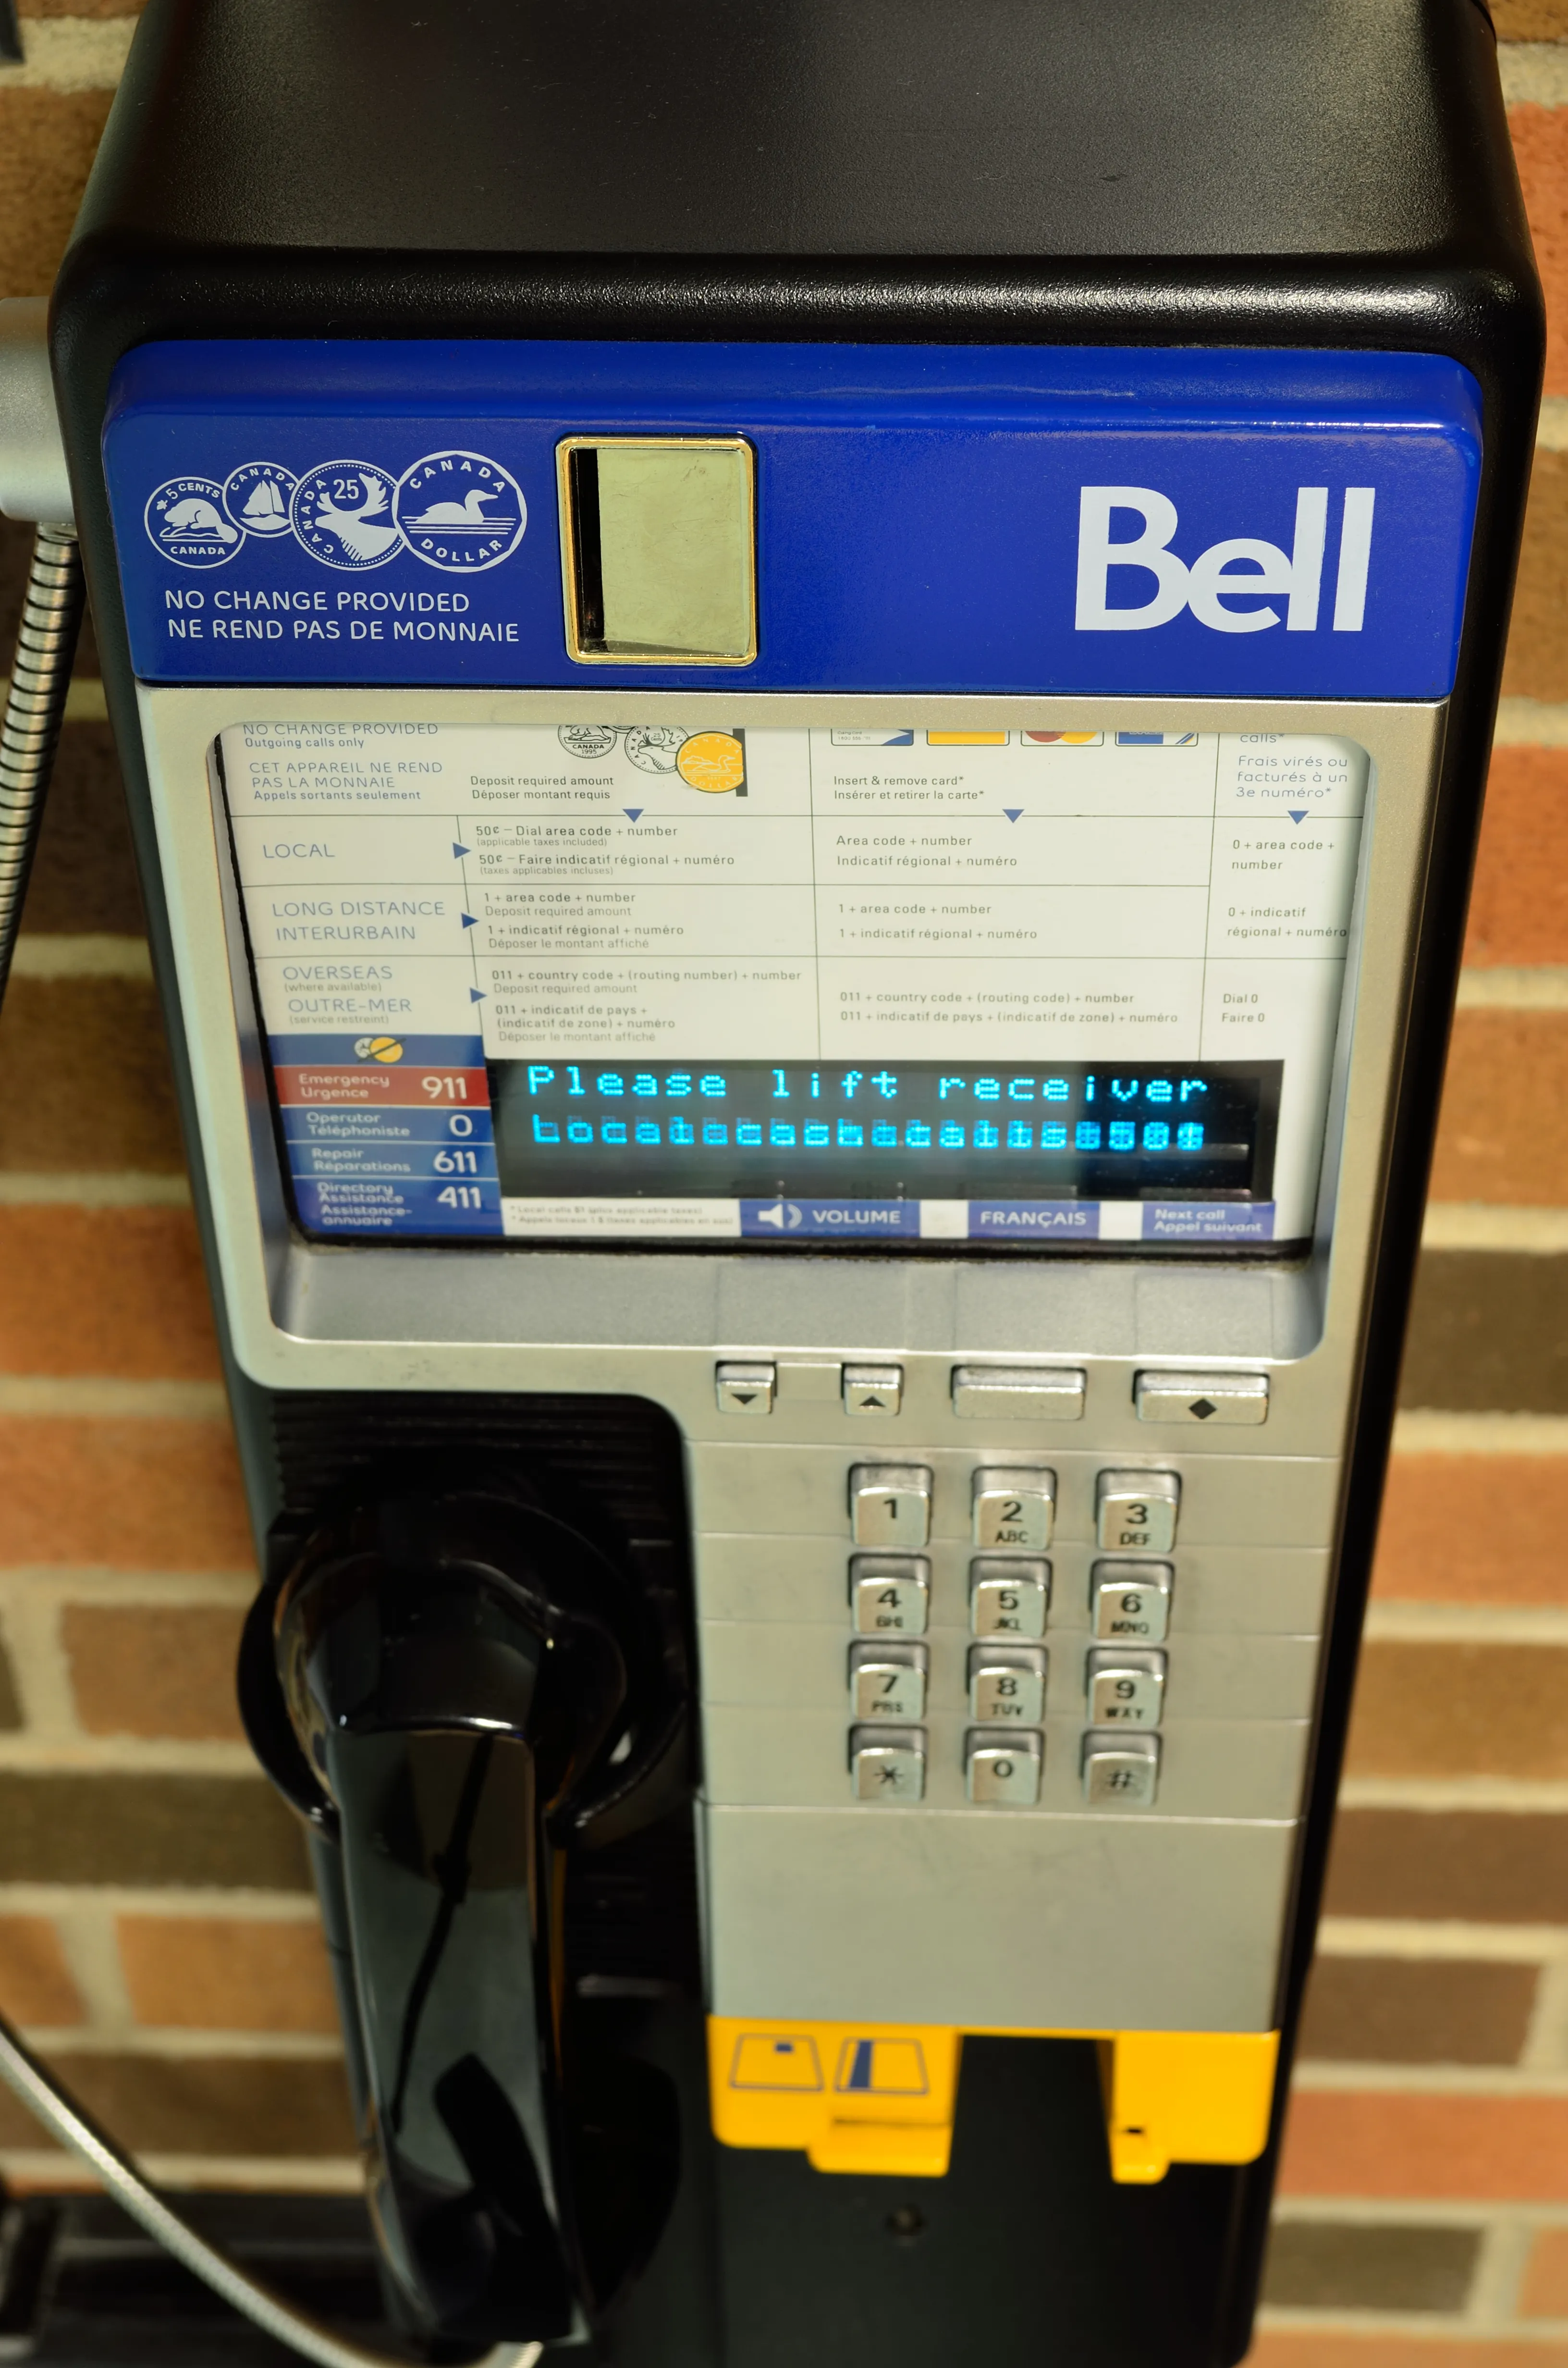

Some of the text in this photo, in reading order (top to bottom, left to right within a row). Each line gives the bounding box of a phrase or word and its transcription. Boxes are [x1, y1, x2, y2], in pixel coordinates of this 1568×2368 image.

[231, 467, 296, 492] CANADA
[410, 460, 506, 493] CANADA
[170, 482, 221, 500] 5 CENTS
[333, 479, 358, 500] 25
[171, 546, 225, 555] CANADA
[420, 537, 503, 563] DOLLAR
[1075, 486, 1375, 632] Bell
[165, 590, 469, 612] NO CHANGE PROVIDED
[168, 619, 519, 642] NE REND PAS DE MONNAIE
[243, 722, 440, 735] NO CHANGE PROVIDED
[245, 737, 364, 749] Outgoing calls only
[249, 762, 442, 773] CET APPAREIL NE REND
[1238, 755, 1348, 767] Frais virés ou
[252, 777, 395, 788] PAS LA MONNAIE
[470, 776, 613, 787] Deposit required amount
[834, 776, 868, 785] Insert
[871, 776, 880, 785] &
[1237, 771, 1306, 782] facturés
[1312, 772, 1322, 782] à
[254, 790, 421, 802] Appels sortants seulement
[472, 789, 610, 801] Déposer montant requis
[834, 790, 876, 800] Insérer
[880, 791, 891, 800] et
[894, 790, 930, 799] retirer
[934, 790, 943, 800] la
[1236, 787, 1255, 797] 3e
[516, 826, 541, 836] Dial
[579, 826, 611, 836] code
[627, 826, 677, 836] number
[477, 838, 530, 847] (applicable
[563, 838, 607, 846] included)
[836, 835, 972, 846] Area code number
[1290, 840, 1323, 850] code
[263, 843, 335, 858] LOCAL
[519, 854, 551, 864] Faire
[556, 854, 610, 864] indicatif
[614, 854, 669, 867] régional
[684, 855, 734, 865] numéro
[837, 855, 1017, 868] Indicatif régional numéro
[1232, 860, 1283, 870] number
[480, 866, 613, 876] (taxes applicables incluses)
[506, 892, 636, 902] area code number
[272, 901, 445, 917] LONG DISTANCE
[894, 904, 926, 914] code
[942, 904, 992, 914] number
[1251, 907, 1306, 917] indicatif
[276, 926, 416, 941] INTERURBAIN
[509, 925, 684, 937] indicatif régional numéro
[861, 928, 1037, 941] indicatif régional numéro
[1227, 926, 1347, 938] régional numéro
[282, 966, 392, 980] OVERSEAS
[840, 992, 1134, 1005] 011 country code (routing code) number
[1223, 993, 1248, 1004] Dial
[288, 999, 412, 1013] OUTRE-MER
[1222, 1012, 1254, 1023] Faire
[299, 1073, 390, 1088] Emergency
[528, 1066, 1207, 1102] Please lift receiver
[301, 1087, 369, 1100] Urgence
[422, 1076, 466, 1099] 911
[306, 1111, 381, 1125] Operator
[449, 1114, 472, 1136] 0
[312, 1147, 363, 1160] Repair
[433, 1151, 477, 1173] 611
[438, 1186, 481, 1209] 411
[813, 1210, 900, 1223] VOLUME
[980, 1211, 1087, 1228] FRANÇAIS
[1155, 1209, 1225, 1220] Next call
[1154, 1221, 1262, 1233] Appel suivant
[884, 1498, 897, 1519] 1
[1001, 1501, 1022, 1522] 2
[1126, 1504, 1147, 1525] 3
[995, 1530, 1026, 1543] ABC
[877, 1589, 900, 1608] 4
[999, 1590, 1018, 1610] 5
[1121, 1594, 1141, 1613] 6
[879, 1674, 897, 1693] 7
[996, 1677, 1017, 1696] 8
[1115, 1680, 1135, 1699] 9
